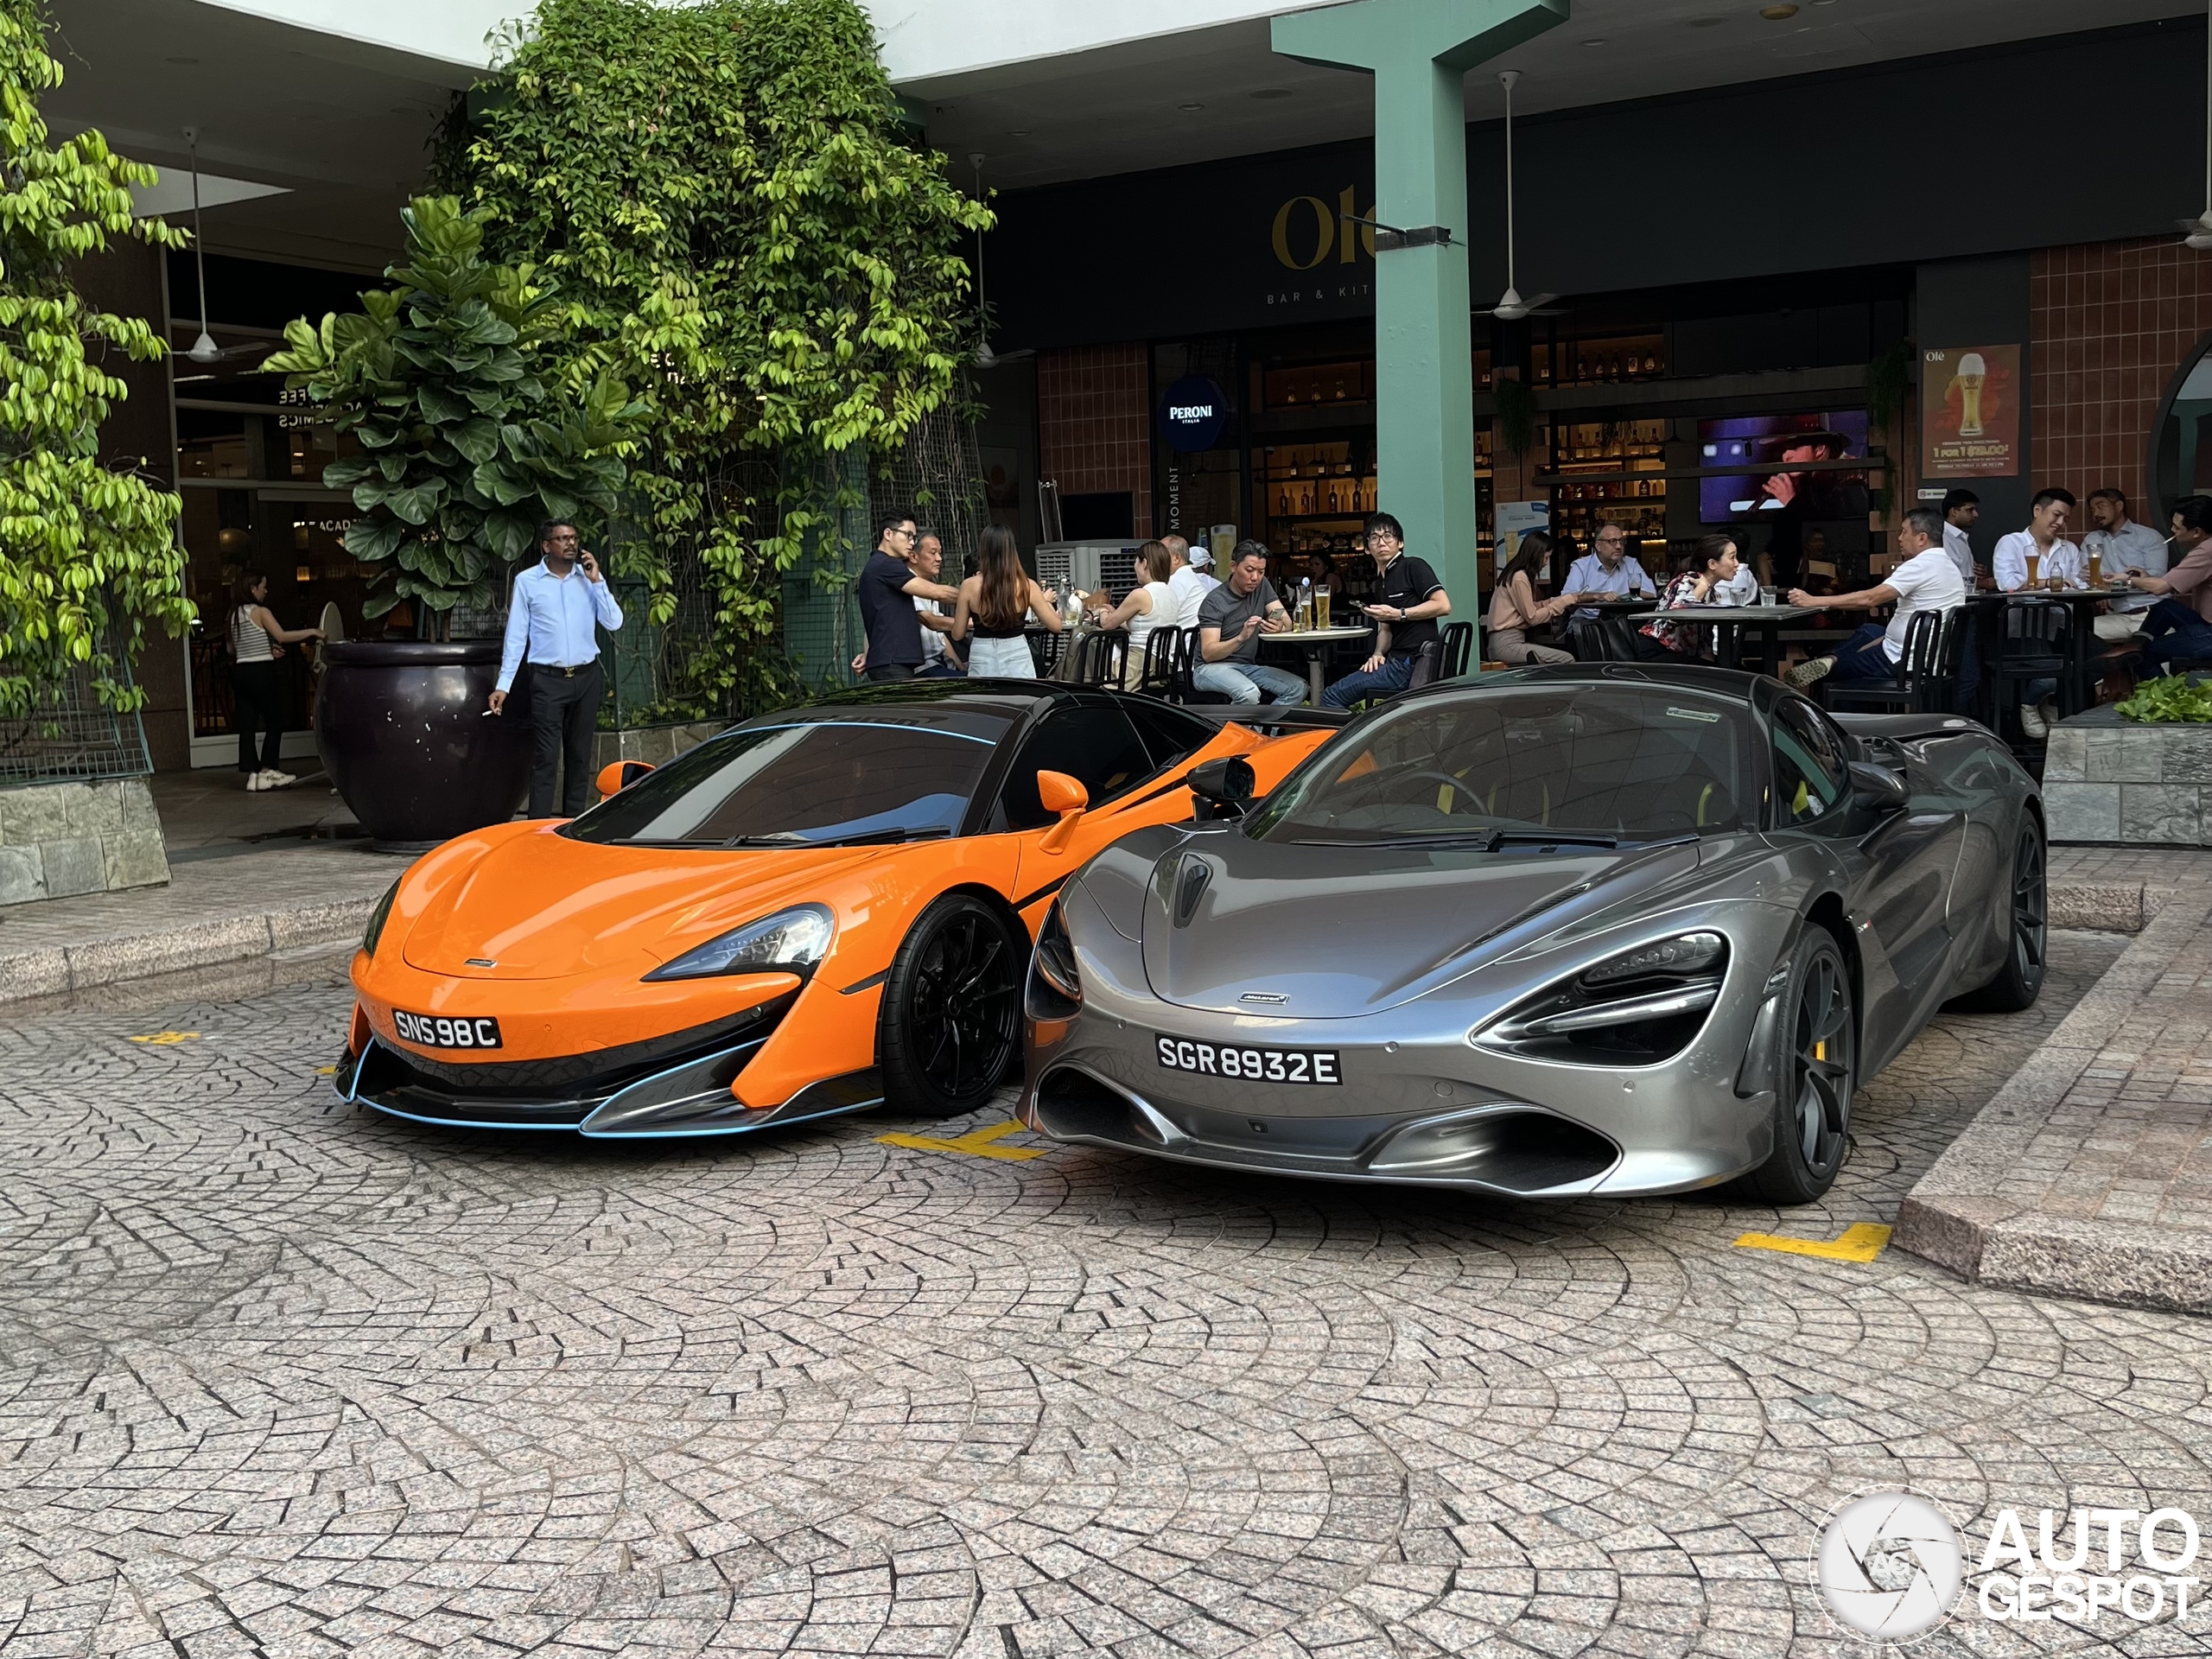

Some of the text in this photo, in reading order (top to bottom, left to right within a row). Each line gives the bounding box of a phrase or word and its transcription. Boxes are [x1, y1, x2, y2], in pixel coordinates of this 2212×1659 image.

[1267, 291, 1300, 305] BAR
[1315, 289, 1323, 300] &
[1169, 404, 1213, 420] PERONI
[1169, 467, 1179, 530] MOMENT
[396, 1011, 497, 1046] SNS98C
[1159, 1038, 1338, 1083] SGR8932E
